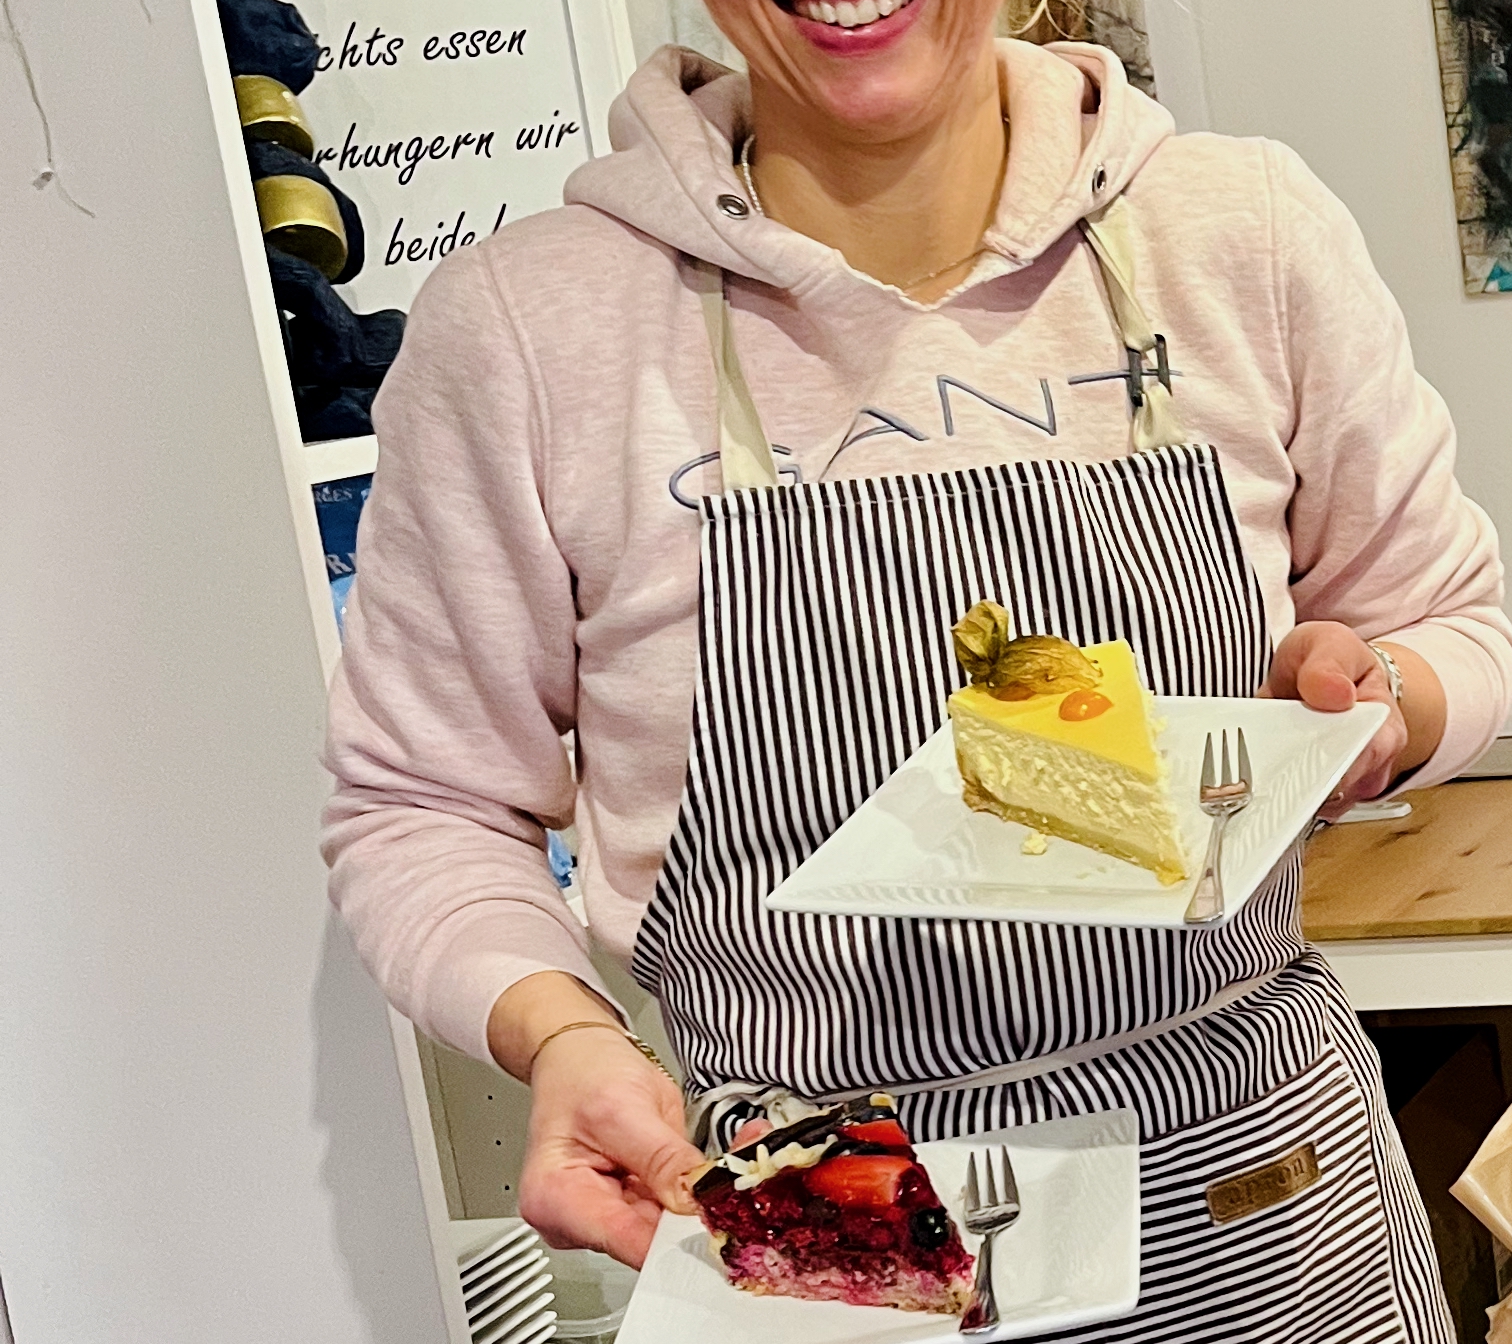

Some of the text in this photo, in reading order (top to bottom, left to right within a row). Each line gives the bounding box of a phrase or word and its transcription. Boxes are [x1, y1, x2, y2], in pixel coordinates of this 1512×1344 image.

[314, 21, 528, 72] chts essen
[314, 109, 580, 186] rhungern wir
